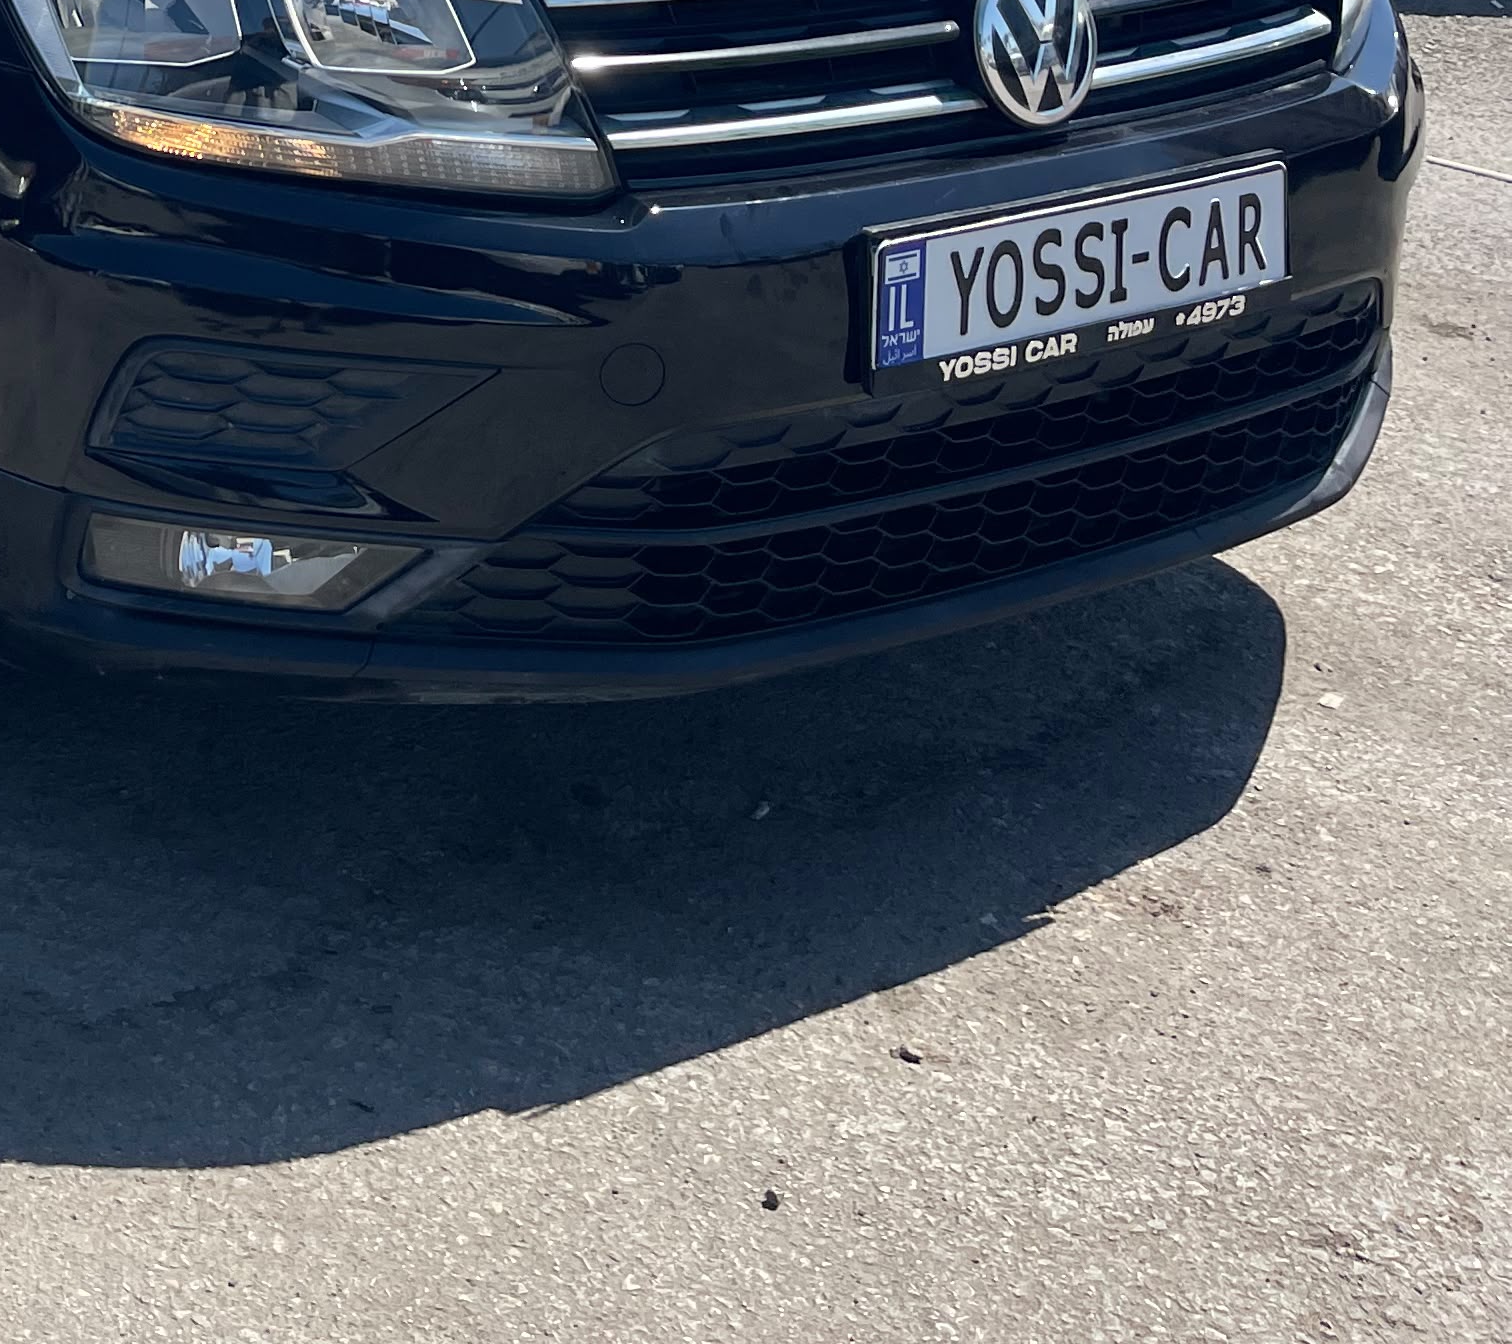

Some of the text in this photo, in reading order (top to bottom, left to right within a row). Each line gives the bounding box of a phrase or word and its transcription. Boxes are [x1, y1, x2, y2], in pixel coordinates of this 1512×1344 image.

[950, 192, 1267, 336] YOSSI-CAR
[888, 283, 914, 332] IL
[1106, 318, 1156, 343] עפולה
[881, 328, 921, 348] ישראל
[939, 333, 1078, 382] YOSSI CAR
